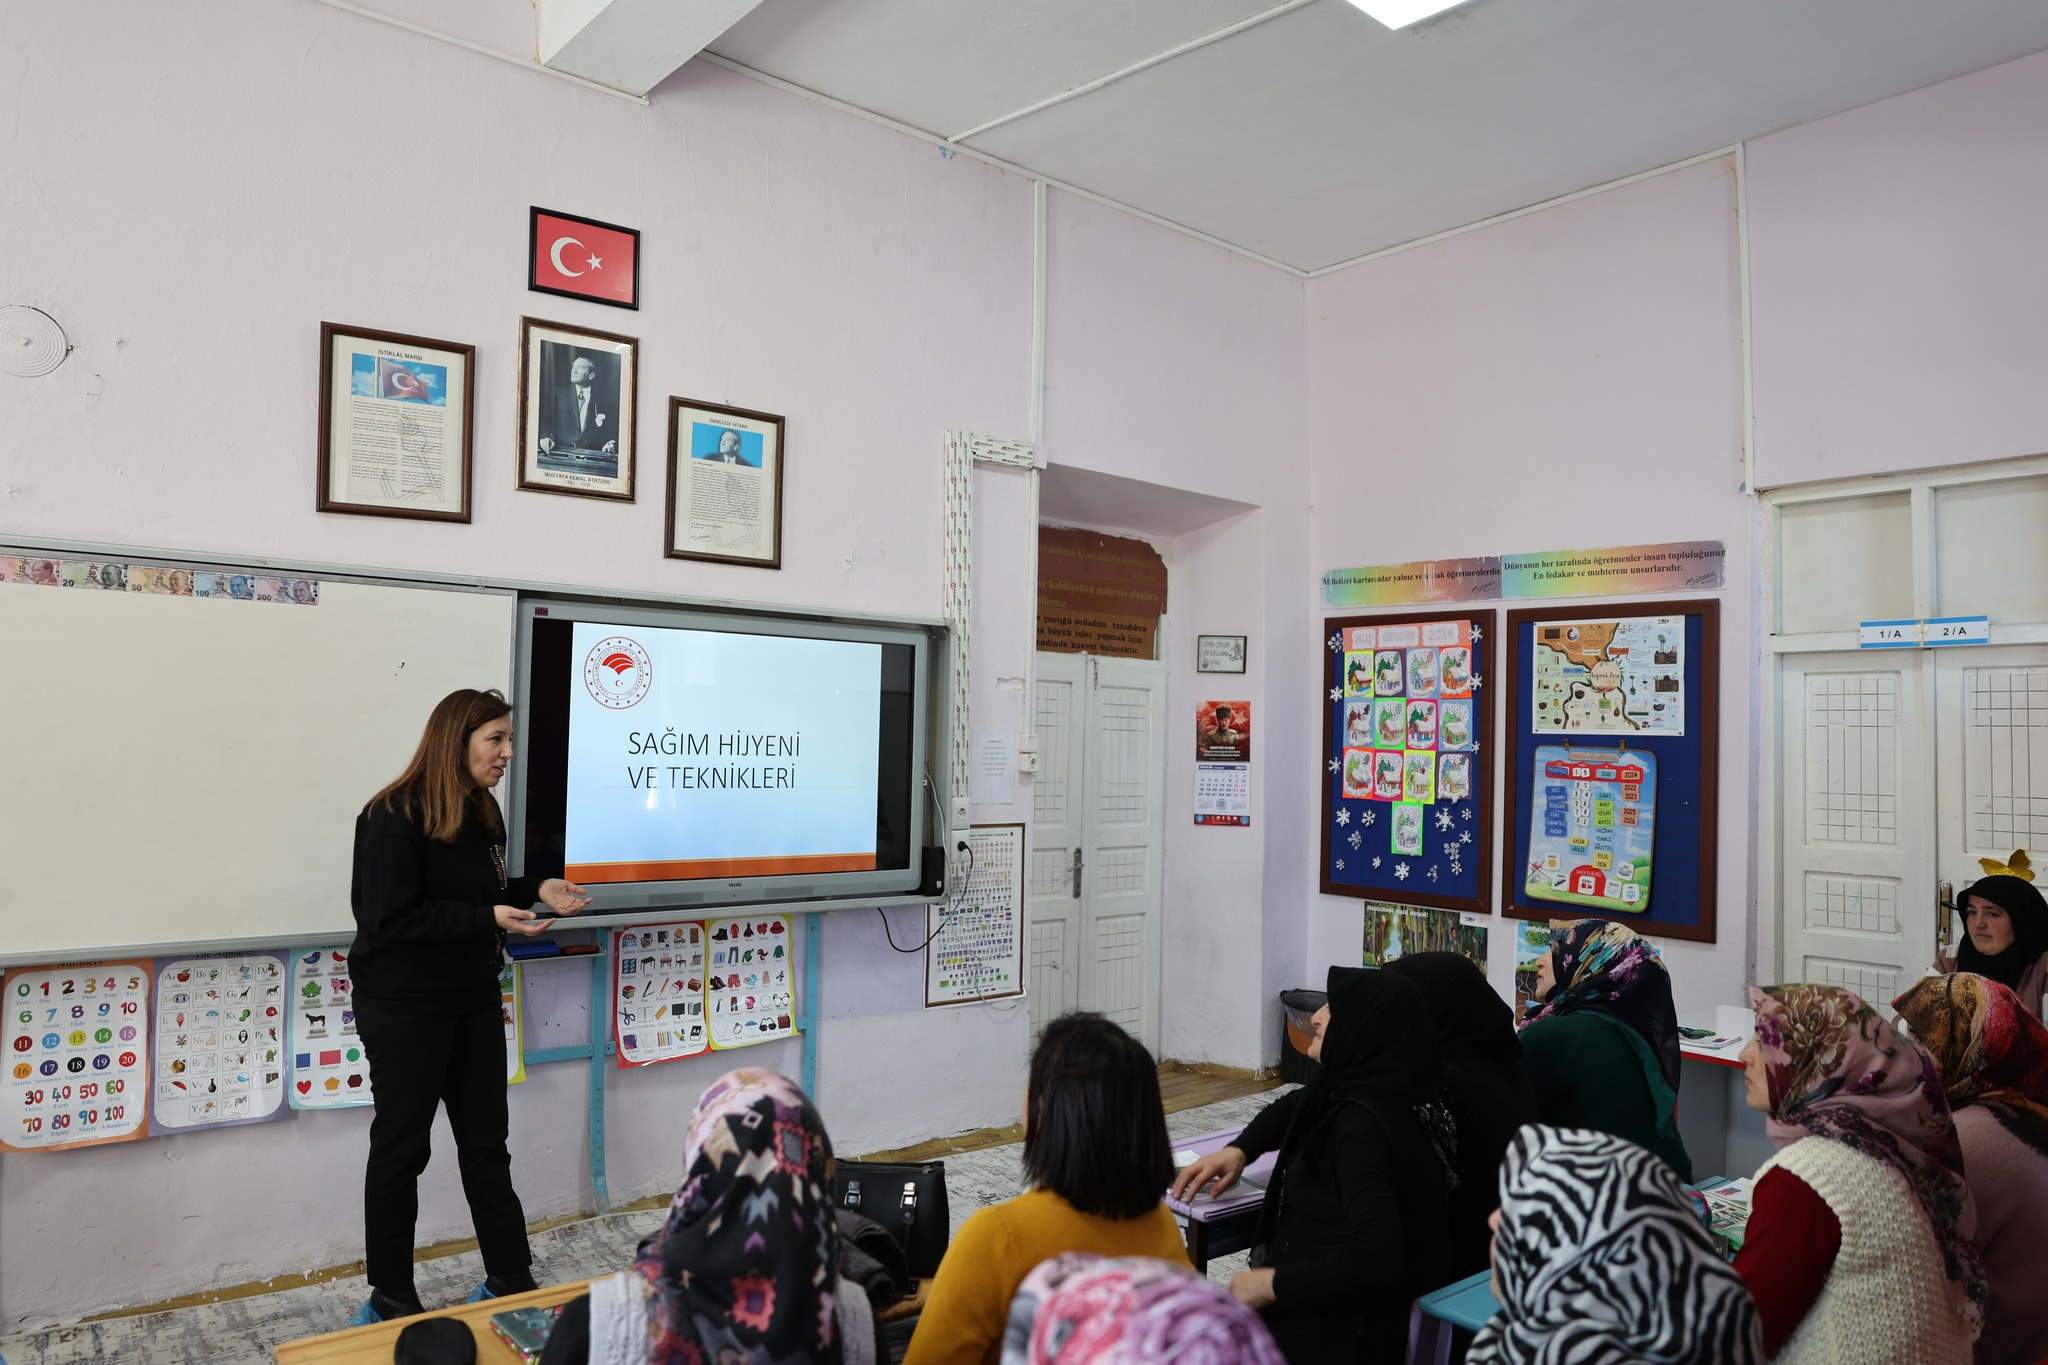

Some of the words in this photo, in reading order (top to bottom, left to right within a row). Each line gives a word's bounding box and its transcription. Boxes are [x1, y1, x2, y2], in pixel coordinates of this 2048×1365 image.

[545, 472, 569, 480] MUSTAFA
[588, 477, 611, 485] ATATÜRK
[1504, 561, 1540, 572] Dünyanın
[1541, 560, 1555, 568] her
[1556, 557, 1592, 568] tarafında
[1594, 554, 1642, 567] öğretmenler
[1644, 553, 1667, 561] insan
[1668, 549, 1726, 561] topluluğunun
[1393, 573, 1413, 583] yalnız
[1447, 568, 1502, 580] öğretmenlerdir.
[1533, 571, 1544, 580] En
[1546, 569, 1576, 579] fedakar
[1588, 566, 1629, 577] muhterem
[1630, 564, 1683, 574] unsurlarıdır.
[62, 578, 75, 588] 20
[131, 584, 143, 592] 50
[195, 589, 210, 598] 100
[257, 593, 272, 602] 200
[1049, 580, 1094, 594] kabiliyetten
[1097, 584, 1128, 597] mahrum
[1129, 590, 1159, 601] olanlara
[1044, 615, 1072, 626] çocuğu
[1075, 618, 1107, 629] ecdadını
[1112, 621, 1147, 632] tanıdıkca
[1047, 627, 1073, 638] büyük
[1075, 630, 1093, 639] işler
[1097, 632, 1126, 642] yapmak
[1129, 635, 1143, 644] için
[1355, 632, 1374, 645] HOŞ
[1383, 630, 1416, 642] GELDİN
[1429, 627, 1455, 641] 2024
[1880, 630, 1885, 639] 1
[1888, 630, 1892, 638] /
[1894, 629, 1902, 638] A
[1943, 627, 1950, 636] 2
[1952, 627, 1956, 636] /
[1959, 626, 1967, 636] A
[1036, 637, 1068, 648] endinde
[1071, 641, 1098, 651] kuvvet
[1100, 643, 1140, 655] bulacaktır.
[628, 726, 709, 756] SAĞIM
[719, 729, 801, 757] HİJYENİ
[628, 766, 659, 789] VE
[667, 762, 796, 789] TEKNİKLERİ
[1624, 771, 1638, 779] 2024
[1625, 792, 1637, 800] 2023
[1624, 808, 1637, 816] 2025
[1623, 817, 1636, 825] 2026
[165, 973, 176, 981] Aa
[257, 966, 268, 975] Dd
[18, 983, 31, 997] 0
[40, 981, 50, 997] 1
[62, 979, 75, 995] 2
[84, 978, 97, 995] 3
[104, 977, 117, 991] 4
[127, 976, 140, 990] 5
[46, 1008, 58, 1023] 7
[71, 1005, 85, 1019] 8
[98, 1003, 111, 1017] 9
[121, 1002, 138, 1015] 10
[20, 1010, 33, 1024] 6
[73, 1034, 83, 1043] 13
[99, 1031, 109, 1041] 14
[123, 1029, 133, 1038] 15
[18, 1039, 28, 1049] 11
[46, 1036, 57, 1046] 12
[71, 1060, 83, 1070] 18
[97, 1057, 107, 1067] 19
[122, 1055, 134, 1065] 20
[18, 1066, 29, 1076] 16
[44, 1063, 55, 1073] 17
[52, 1085, 72, 1103] 40
[80, 1083, 99, 1100] 50
[106, 1079, 125, 1095] 60
[25, 1089, 44, 1106] 30
[79, 1110, 98, 1126] 90
[105, 1105, 125, 1122] 100
[23, 1117, 42, 1133] 70
[52, 1114, 71, 1130] 80
